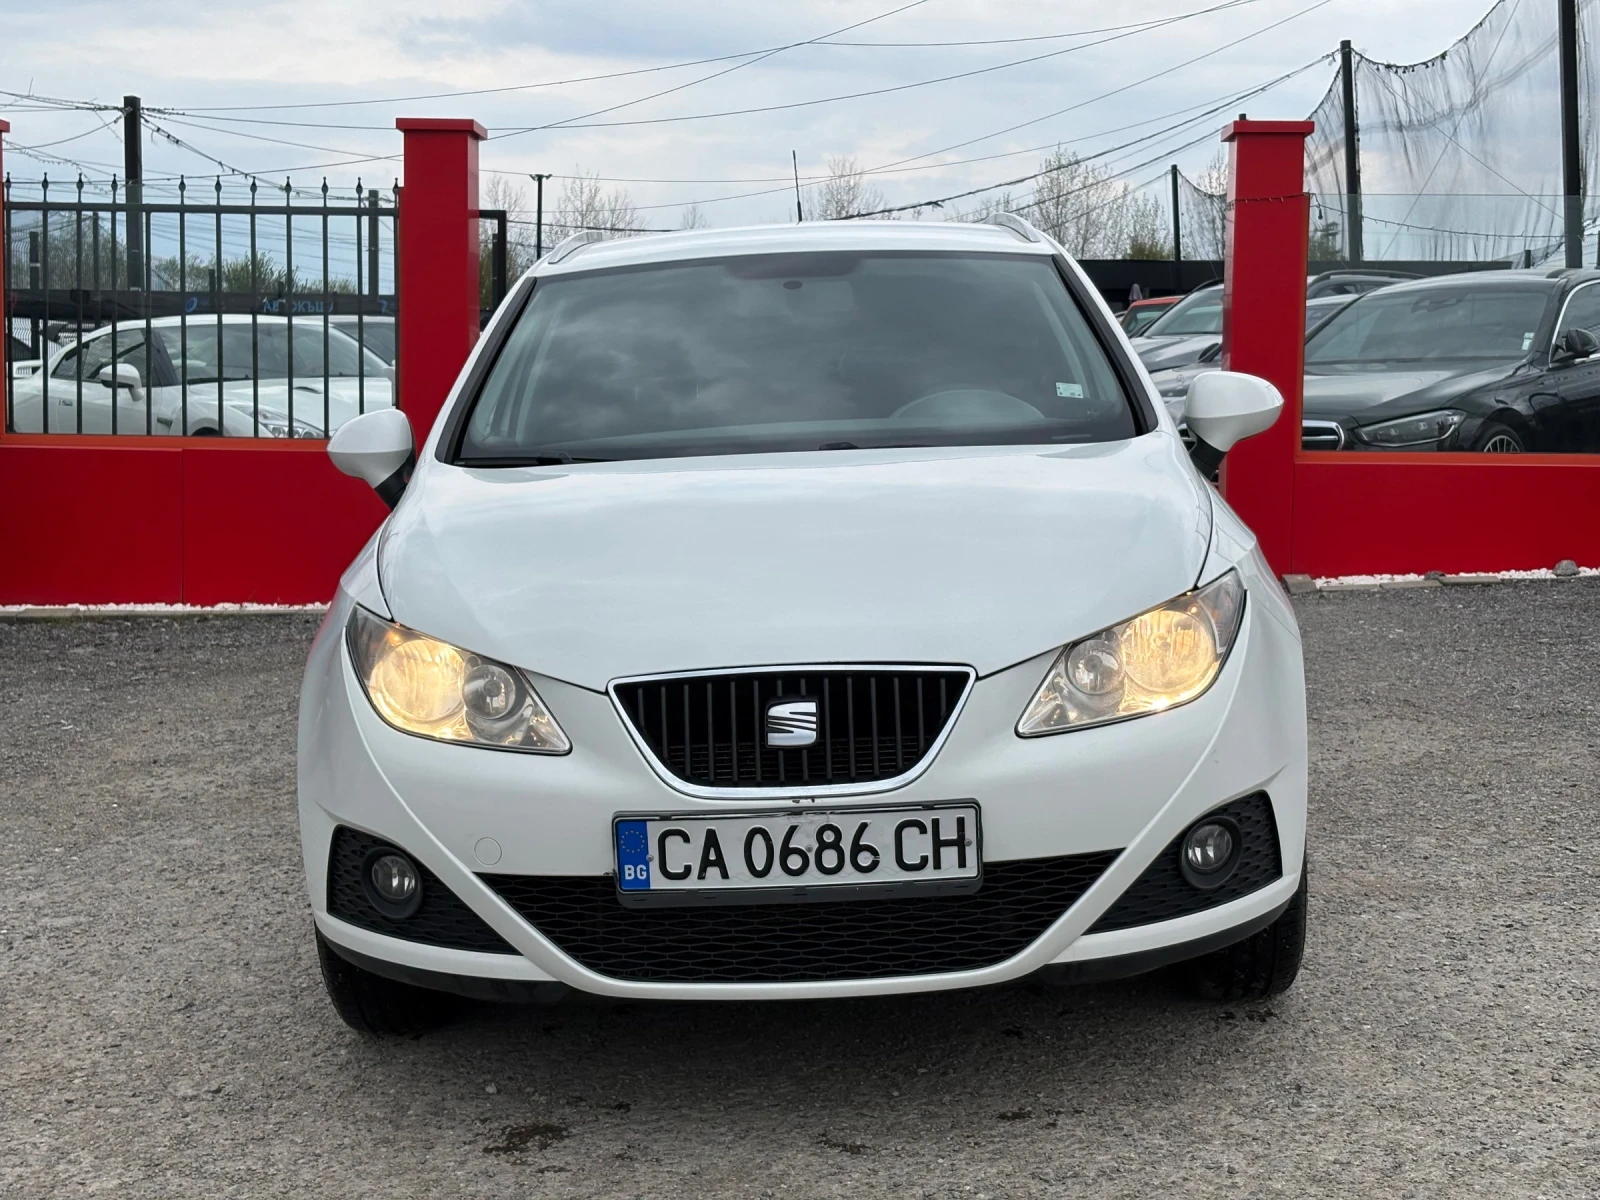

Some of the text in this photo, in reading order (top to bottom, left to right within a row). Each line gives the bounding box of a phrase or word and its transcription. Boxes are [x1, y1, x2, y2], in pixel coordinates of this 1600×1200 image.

[657, 816, 967, 881] CA 0686 CH
[623, 865, 648, 880] BG
